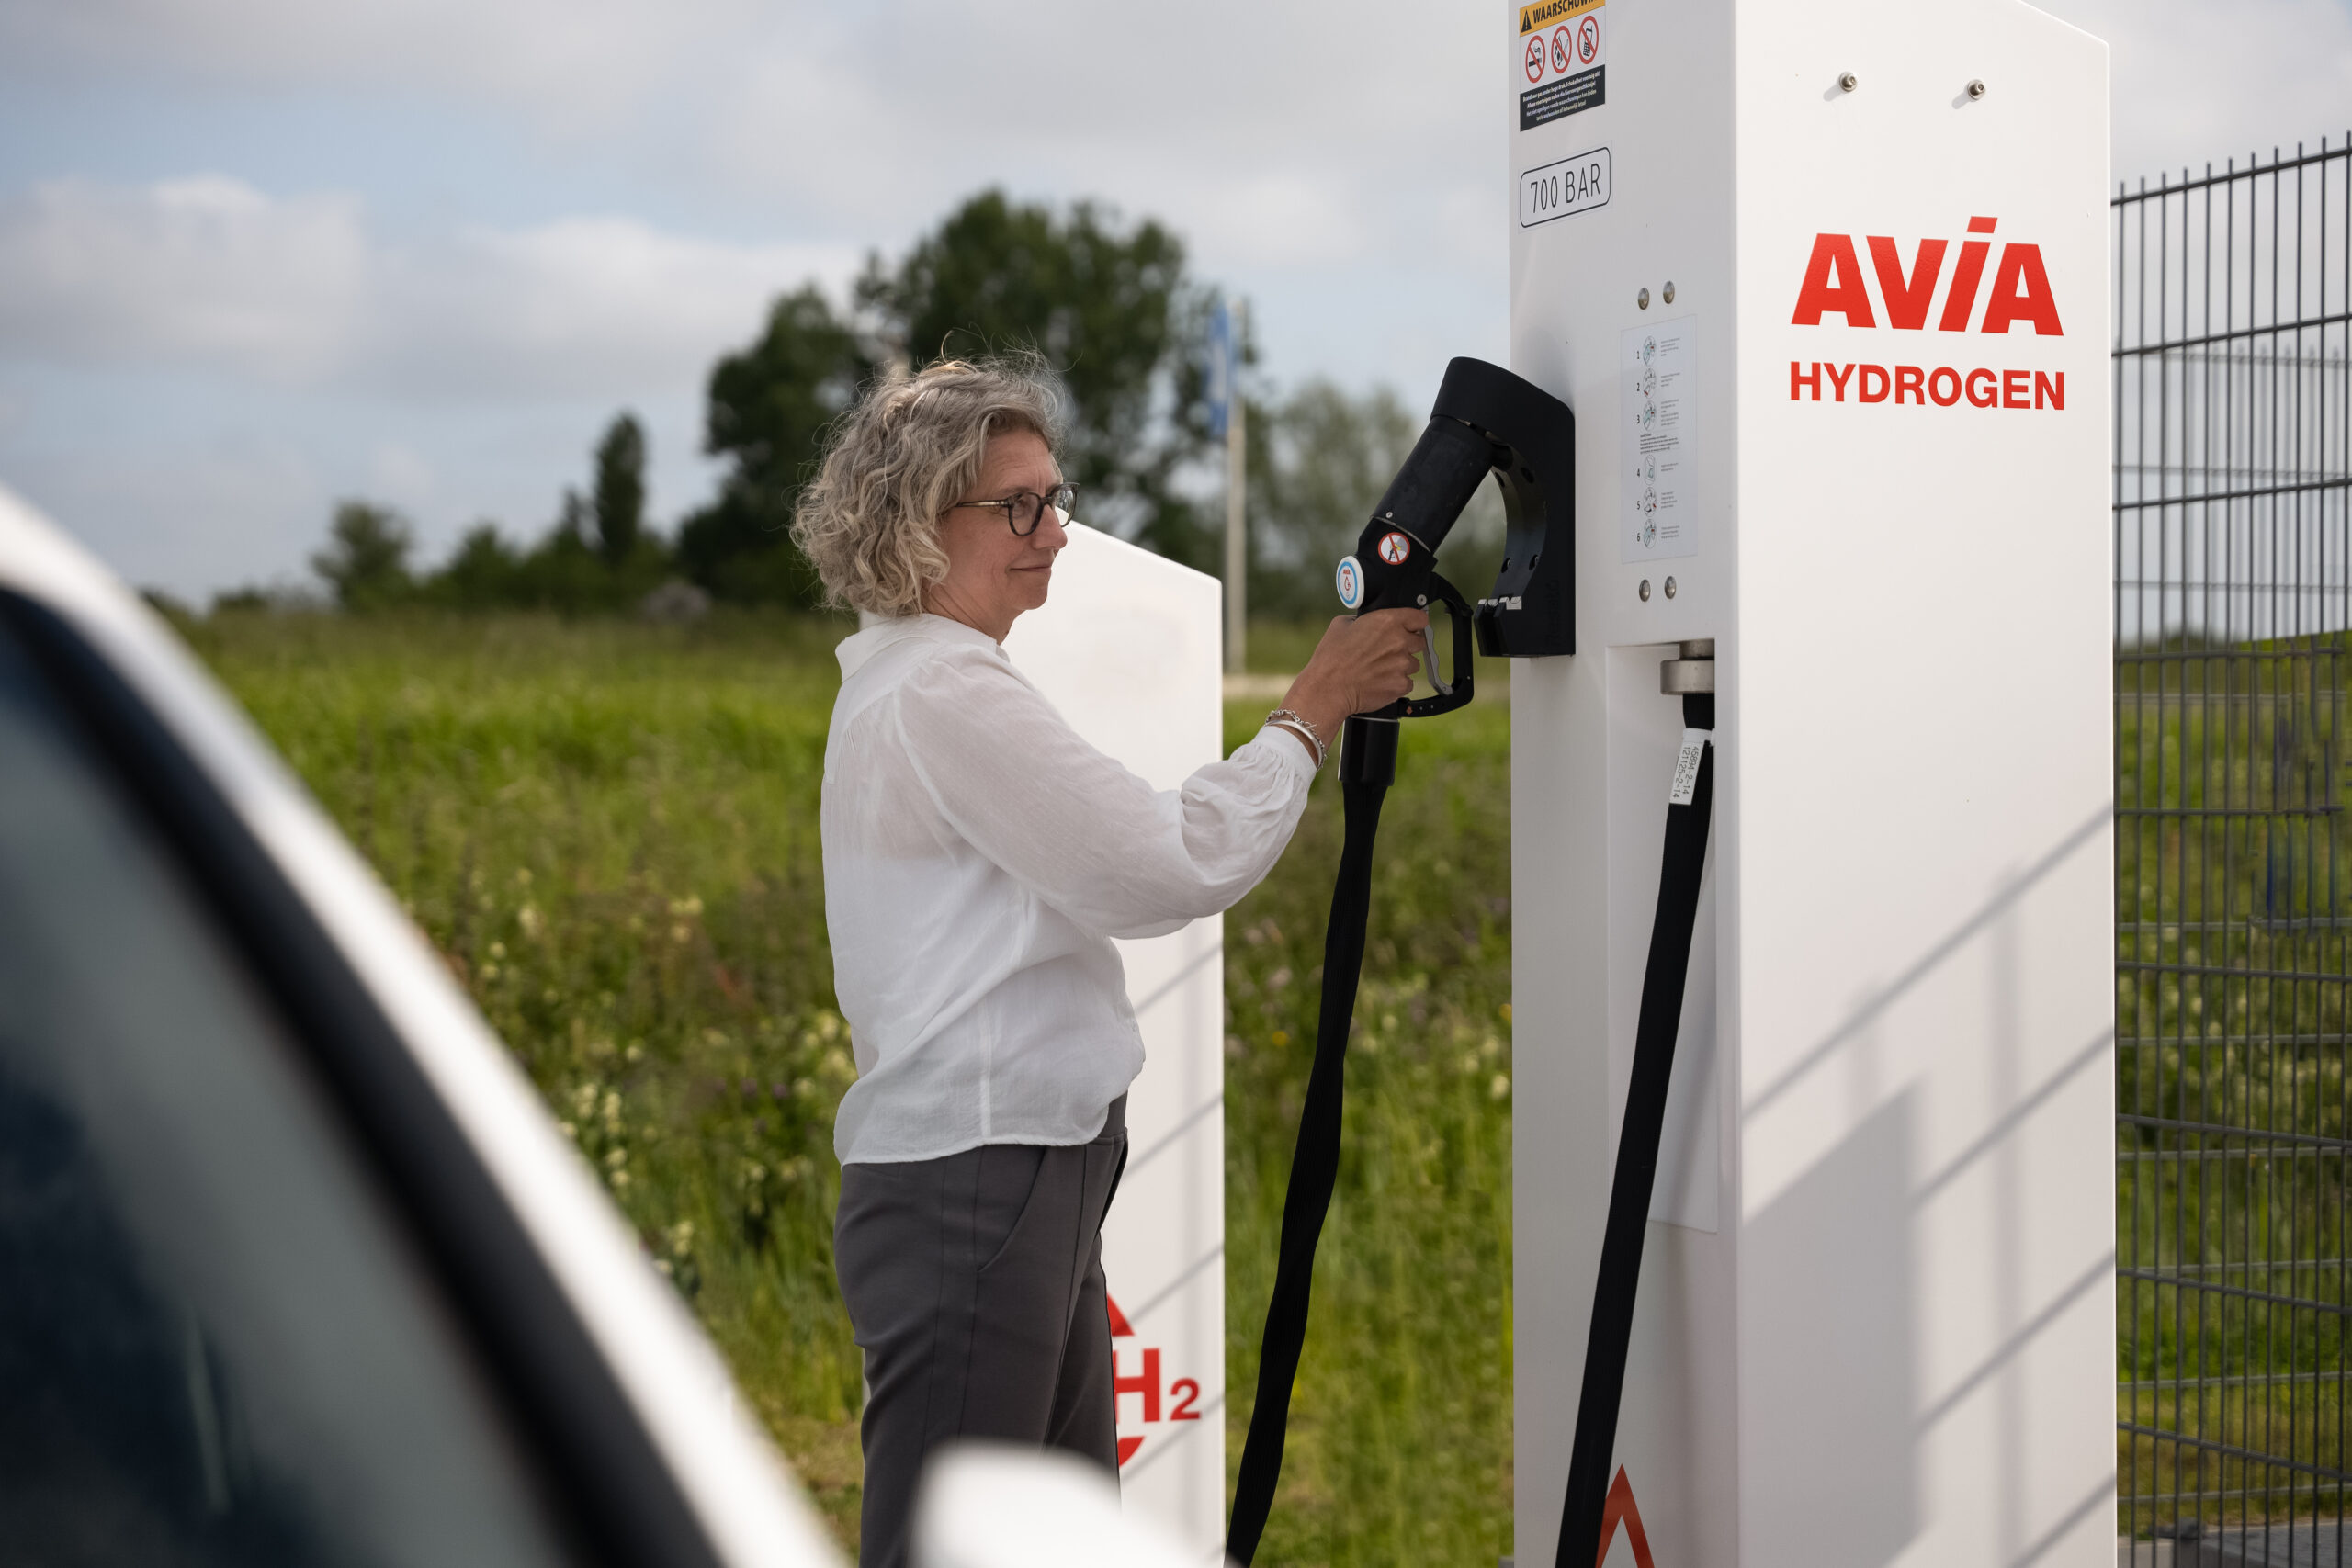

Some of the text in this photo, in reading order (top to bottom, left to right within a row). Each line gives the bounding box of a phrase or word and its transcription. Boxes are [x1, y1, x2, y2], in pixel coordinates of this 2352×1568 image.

[1533, 0, 1593, 23] WAARSCHU
[1530, 163, 1600, 214] 700 BAR
[1791, 361, 2064, 411] HYDROGEN
[1113, 1348, 1201, 1425] H2
